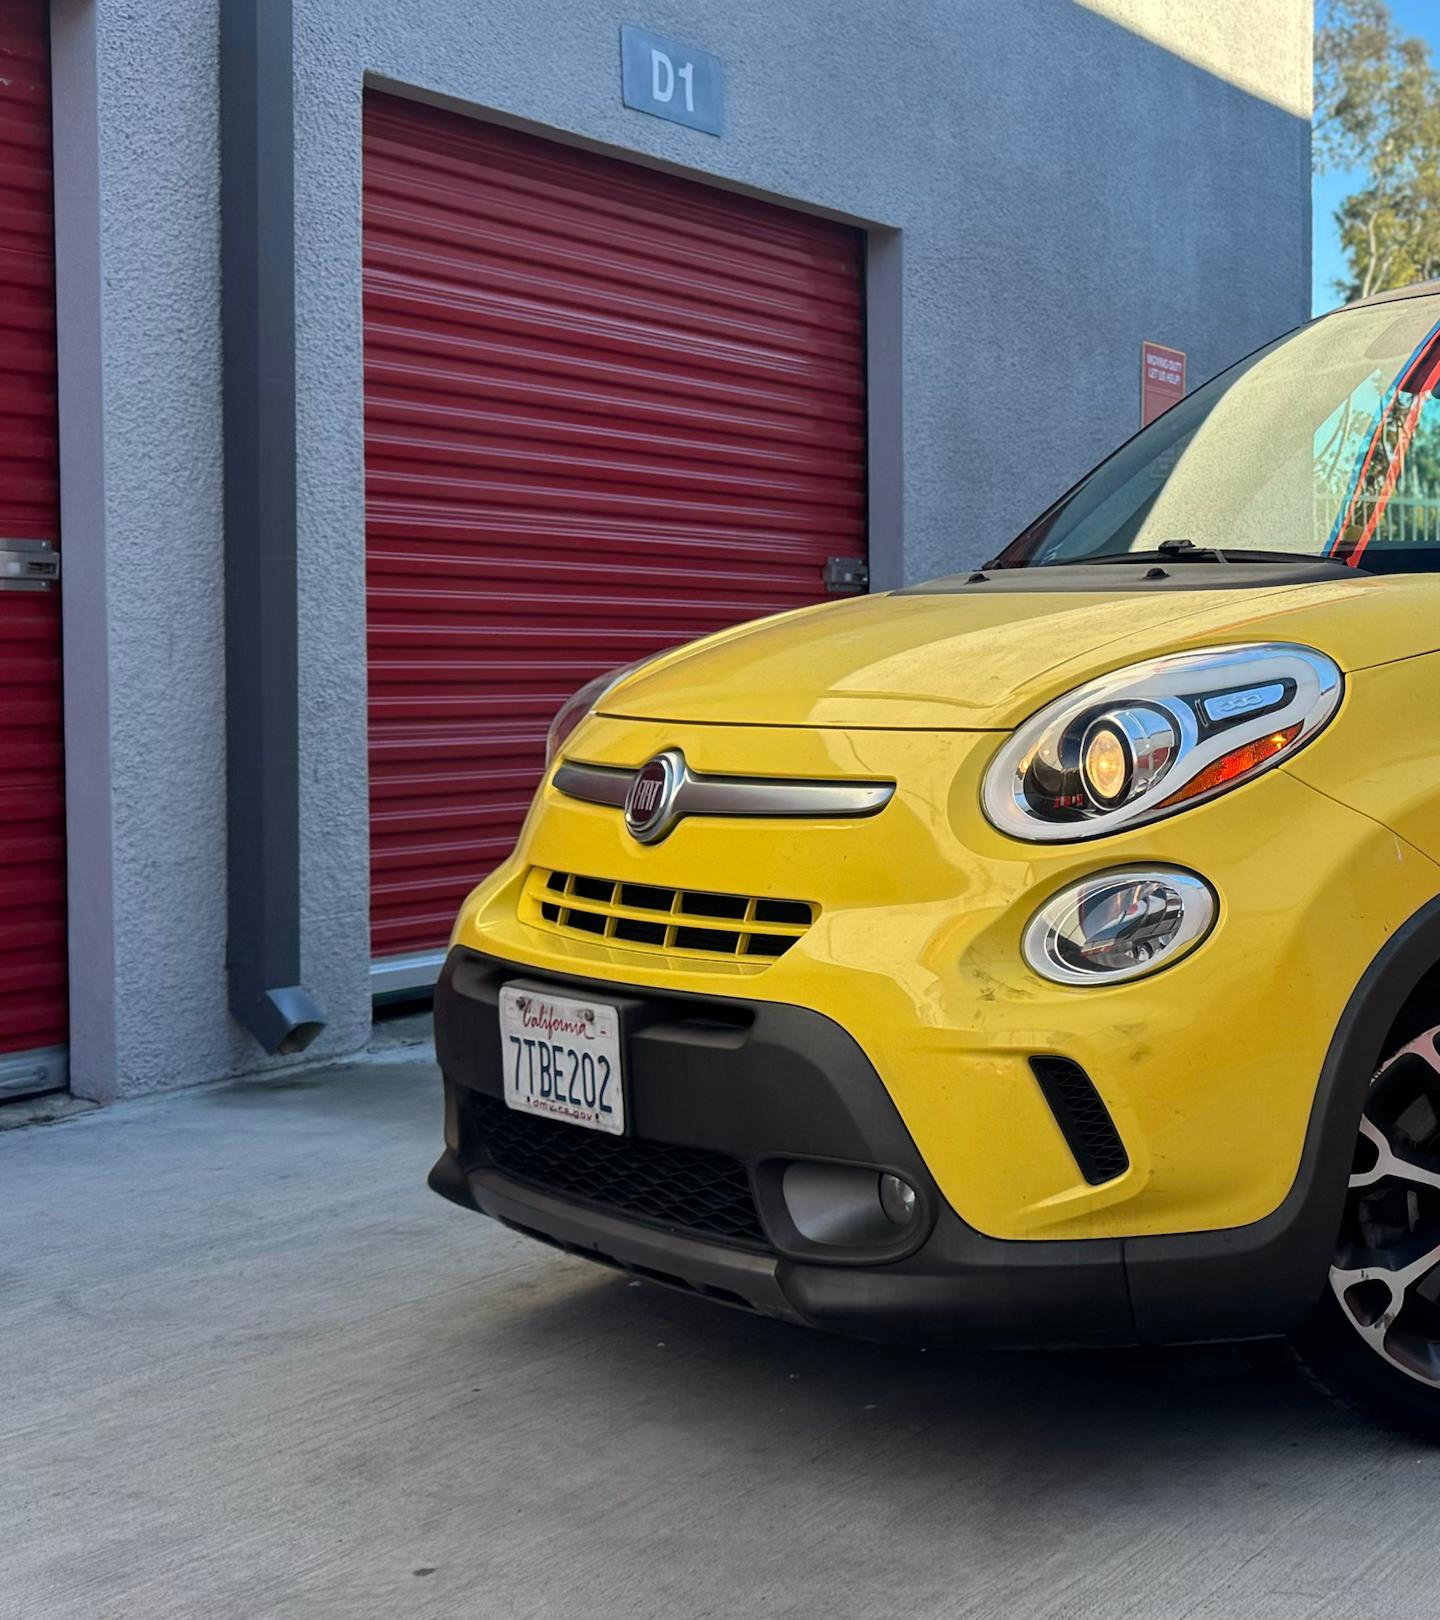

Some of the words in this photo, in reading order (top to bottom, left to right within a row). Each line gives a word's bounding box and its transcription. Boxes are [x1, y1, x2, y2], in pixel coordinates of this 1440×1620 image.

[651, 48, 694, 113] D1
[632, 779, 663, 812] FIAT
[522, 998, 596, 1040] California
[509, 1035, 613, 1113] 7TBE202
